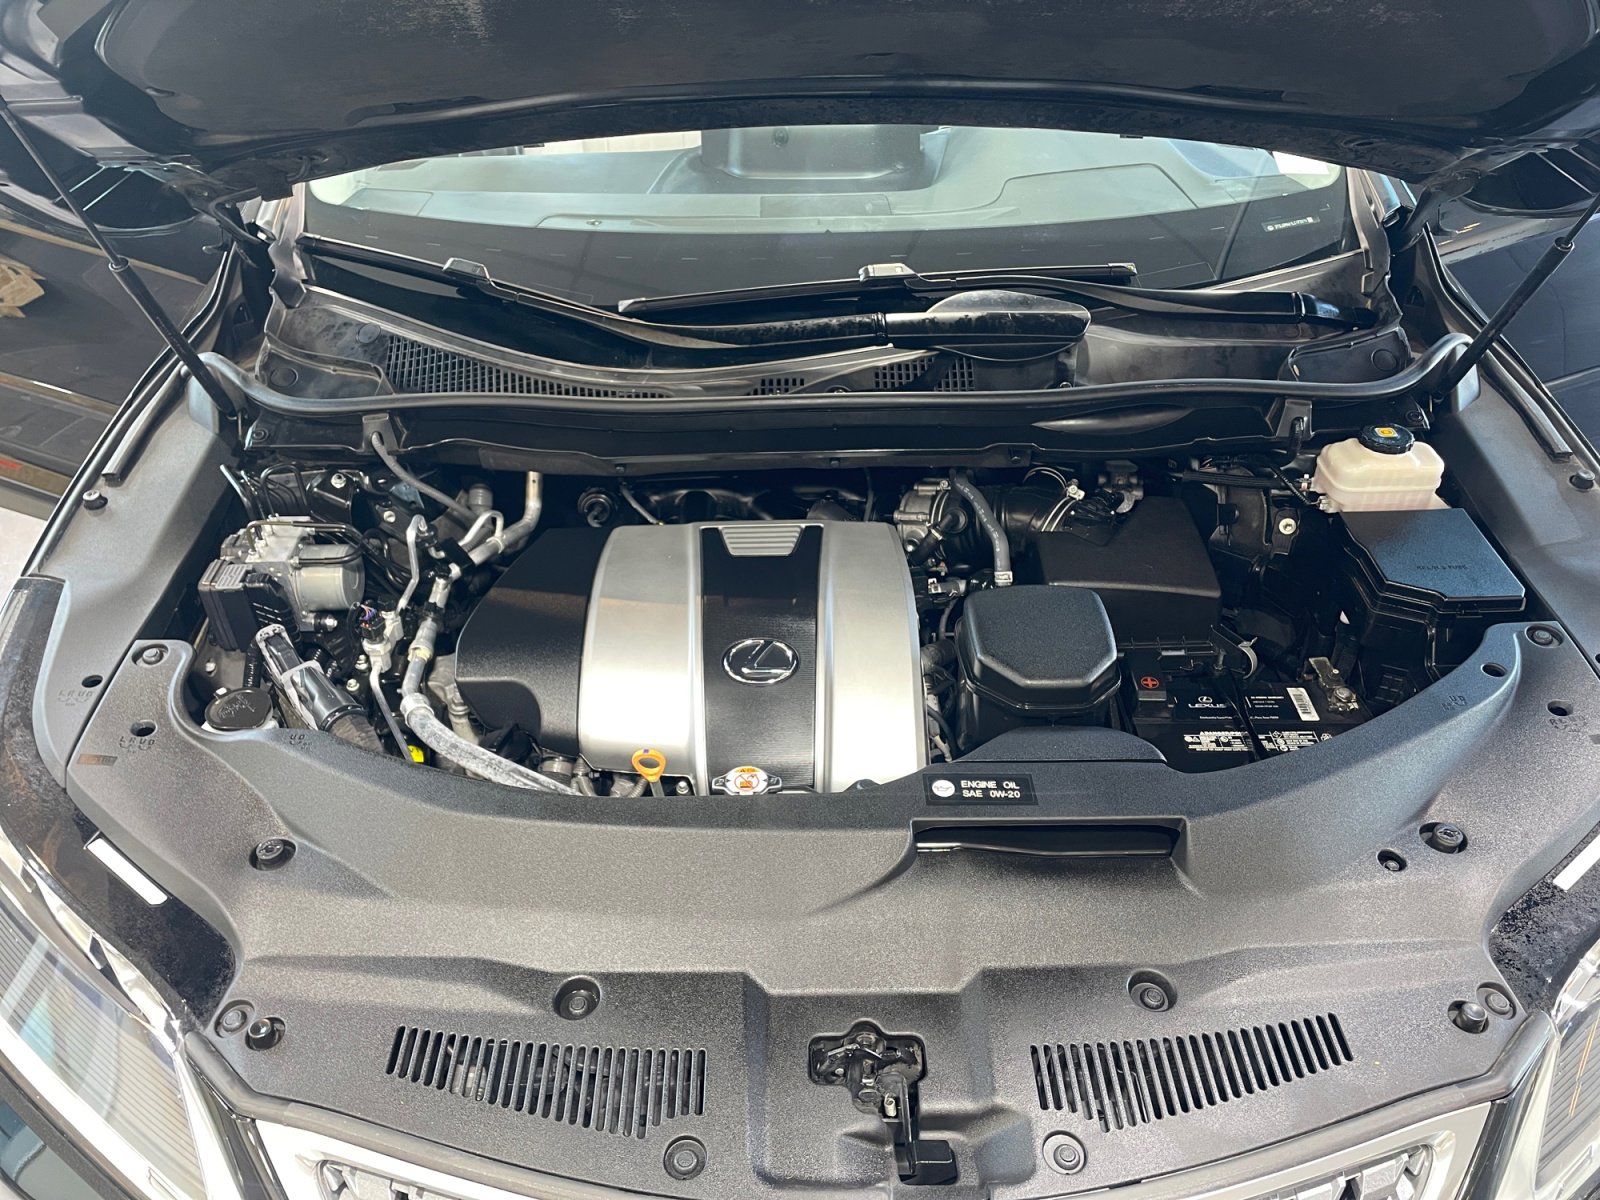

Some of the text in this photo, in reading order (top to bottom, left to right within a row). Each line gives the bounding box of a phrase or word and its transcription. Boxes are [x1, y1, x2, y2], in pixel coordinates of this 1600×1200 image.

[960, 780, 1020, 789] ENGINE OIL
[962, 789, 1021, 798] SAE 0W-20
